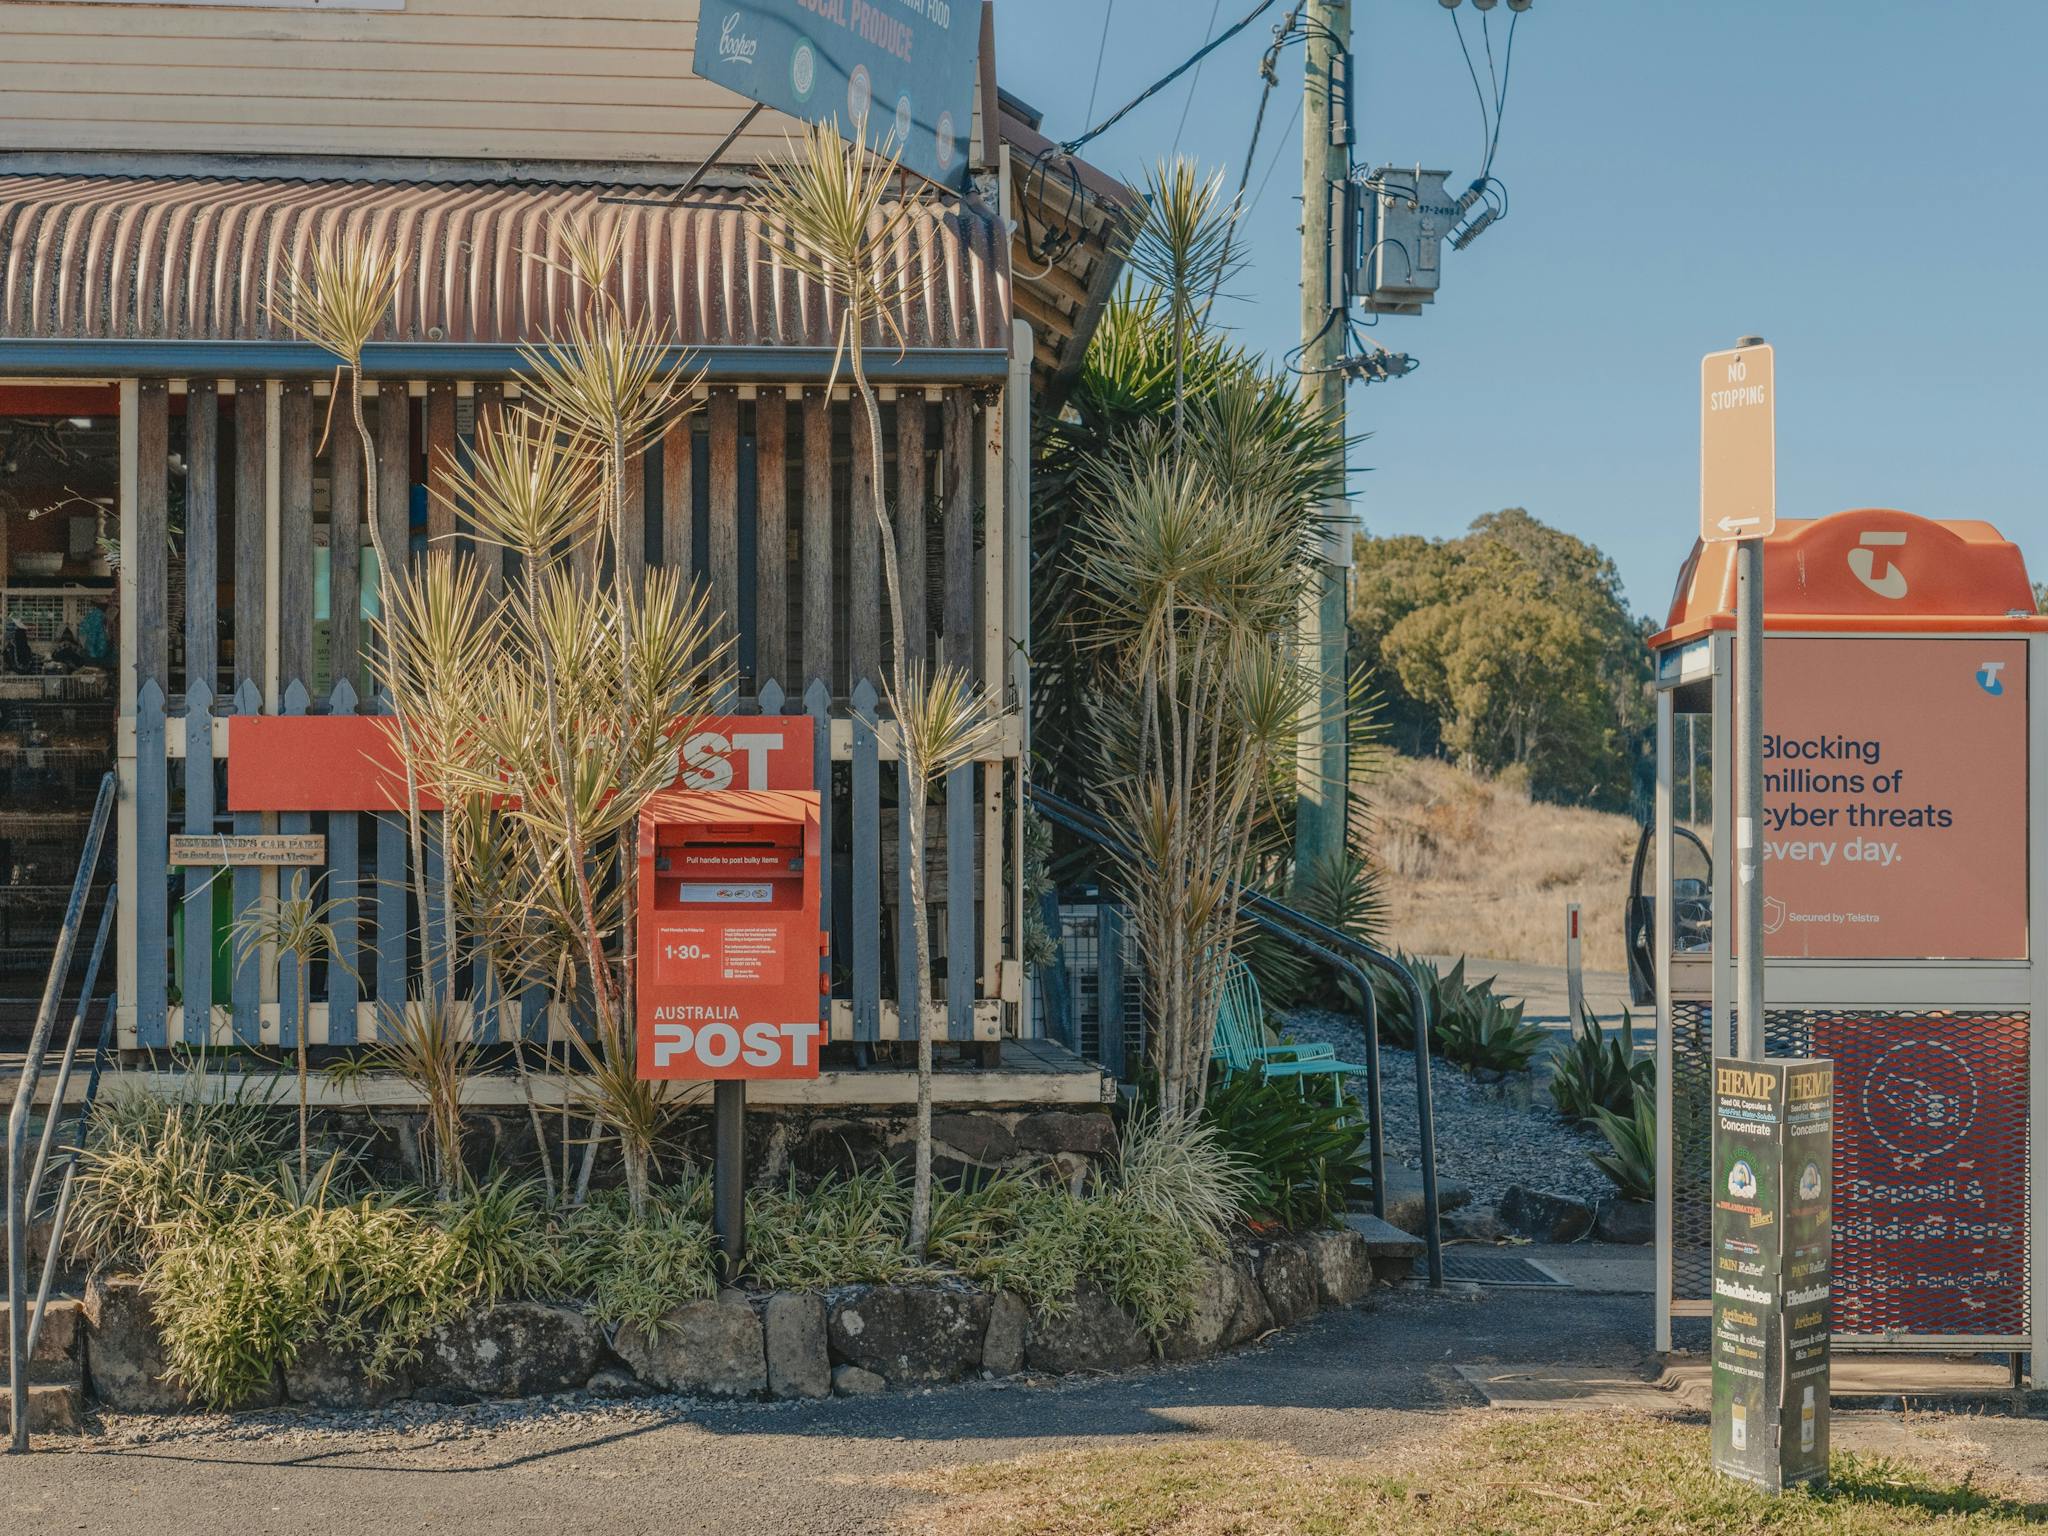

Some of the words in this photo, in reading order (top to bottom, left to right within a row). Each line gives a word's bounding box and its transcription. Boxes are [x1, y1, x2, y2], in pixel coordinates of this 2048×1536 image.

[927, 0, 950, 29] FOOD
[720, 12, 757, 64] Coopers
[797, 0, 847, 27] CAL
[850, 0, 913, 64] PRODUCE
[1727, 361, 1747, 383] NO
[1710, 385, 1765, 411] STOPPING
[1763, 735, 1880, 764] Blocking
[1763, 769, 1864, 793] millions
[1872, 769, 1903, 793] of
[1763, 803, 1839, 831] cyber
[1846, 803, 1953, 828] threats
[729, 857, 743, 866] post
[744, 857, 761, 866] bulky
[1763, 840, 1837, 866] every
[1843, 837, 1903, 867] day.
[1789, 912, 1831, 922] Secured
[1832, 912, 1845, 924] by
[1846, 912, 1880, 922] Telstra
[654, 1006, 739, 1020] AUSTRALIA
[654, 1023, 820, 1067] POST
[1717, 1068, 1776, 1101] HEMP
[1788, 1071, 1832, 1102] HEMP
[1720, 1097, 1732, 1106] Seed
[1741, 1100, 1766, 1112] Capsules
[1721, 1117, 1771, 1136] Concentrate
[1791, 1121, 1829, 1137] Concentrate
[1719, 1256, 1737, 1273] PAIN
[1738, 1259, 1765, 1277] Relief
[1716, 1278, 1772, 1305] Headaches
[1722, 1308, 1758, 1327] Arthritis
[1746, 1335, 1766, 1348] other
